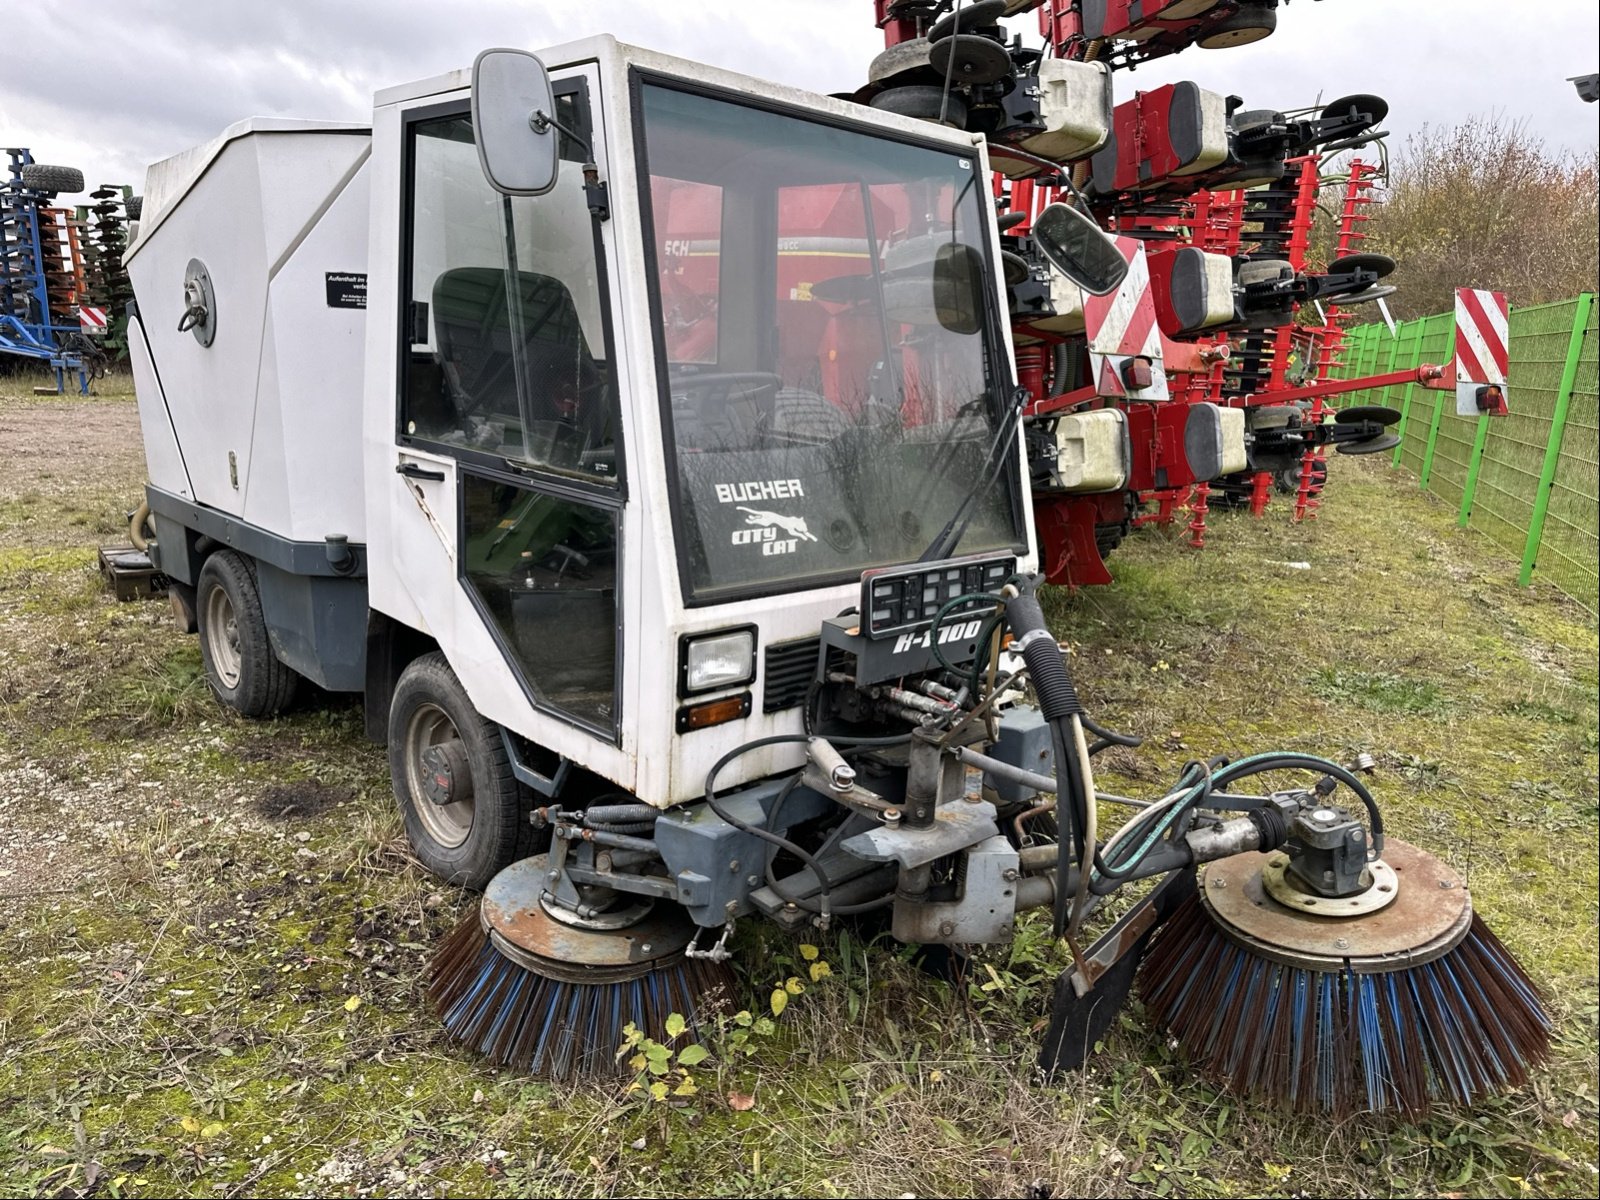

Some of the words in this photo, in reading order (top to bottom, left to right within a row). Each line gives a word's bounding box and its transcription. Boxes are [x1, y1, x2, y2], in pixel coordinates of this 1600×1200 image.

[714, 478, 804, 503] BUCHER
[731, 527, 777, 546] CITY
[762, 539, 798, 556] CAT
